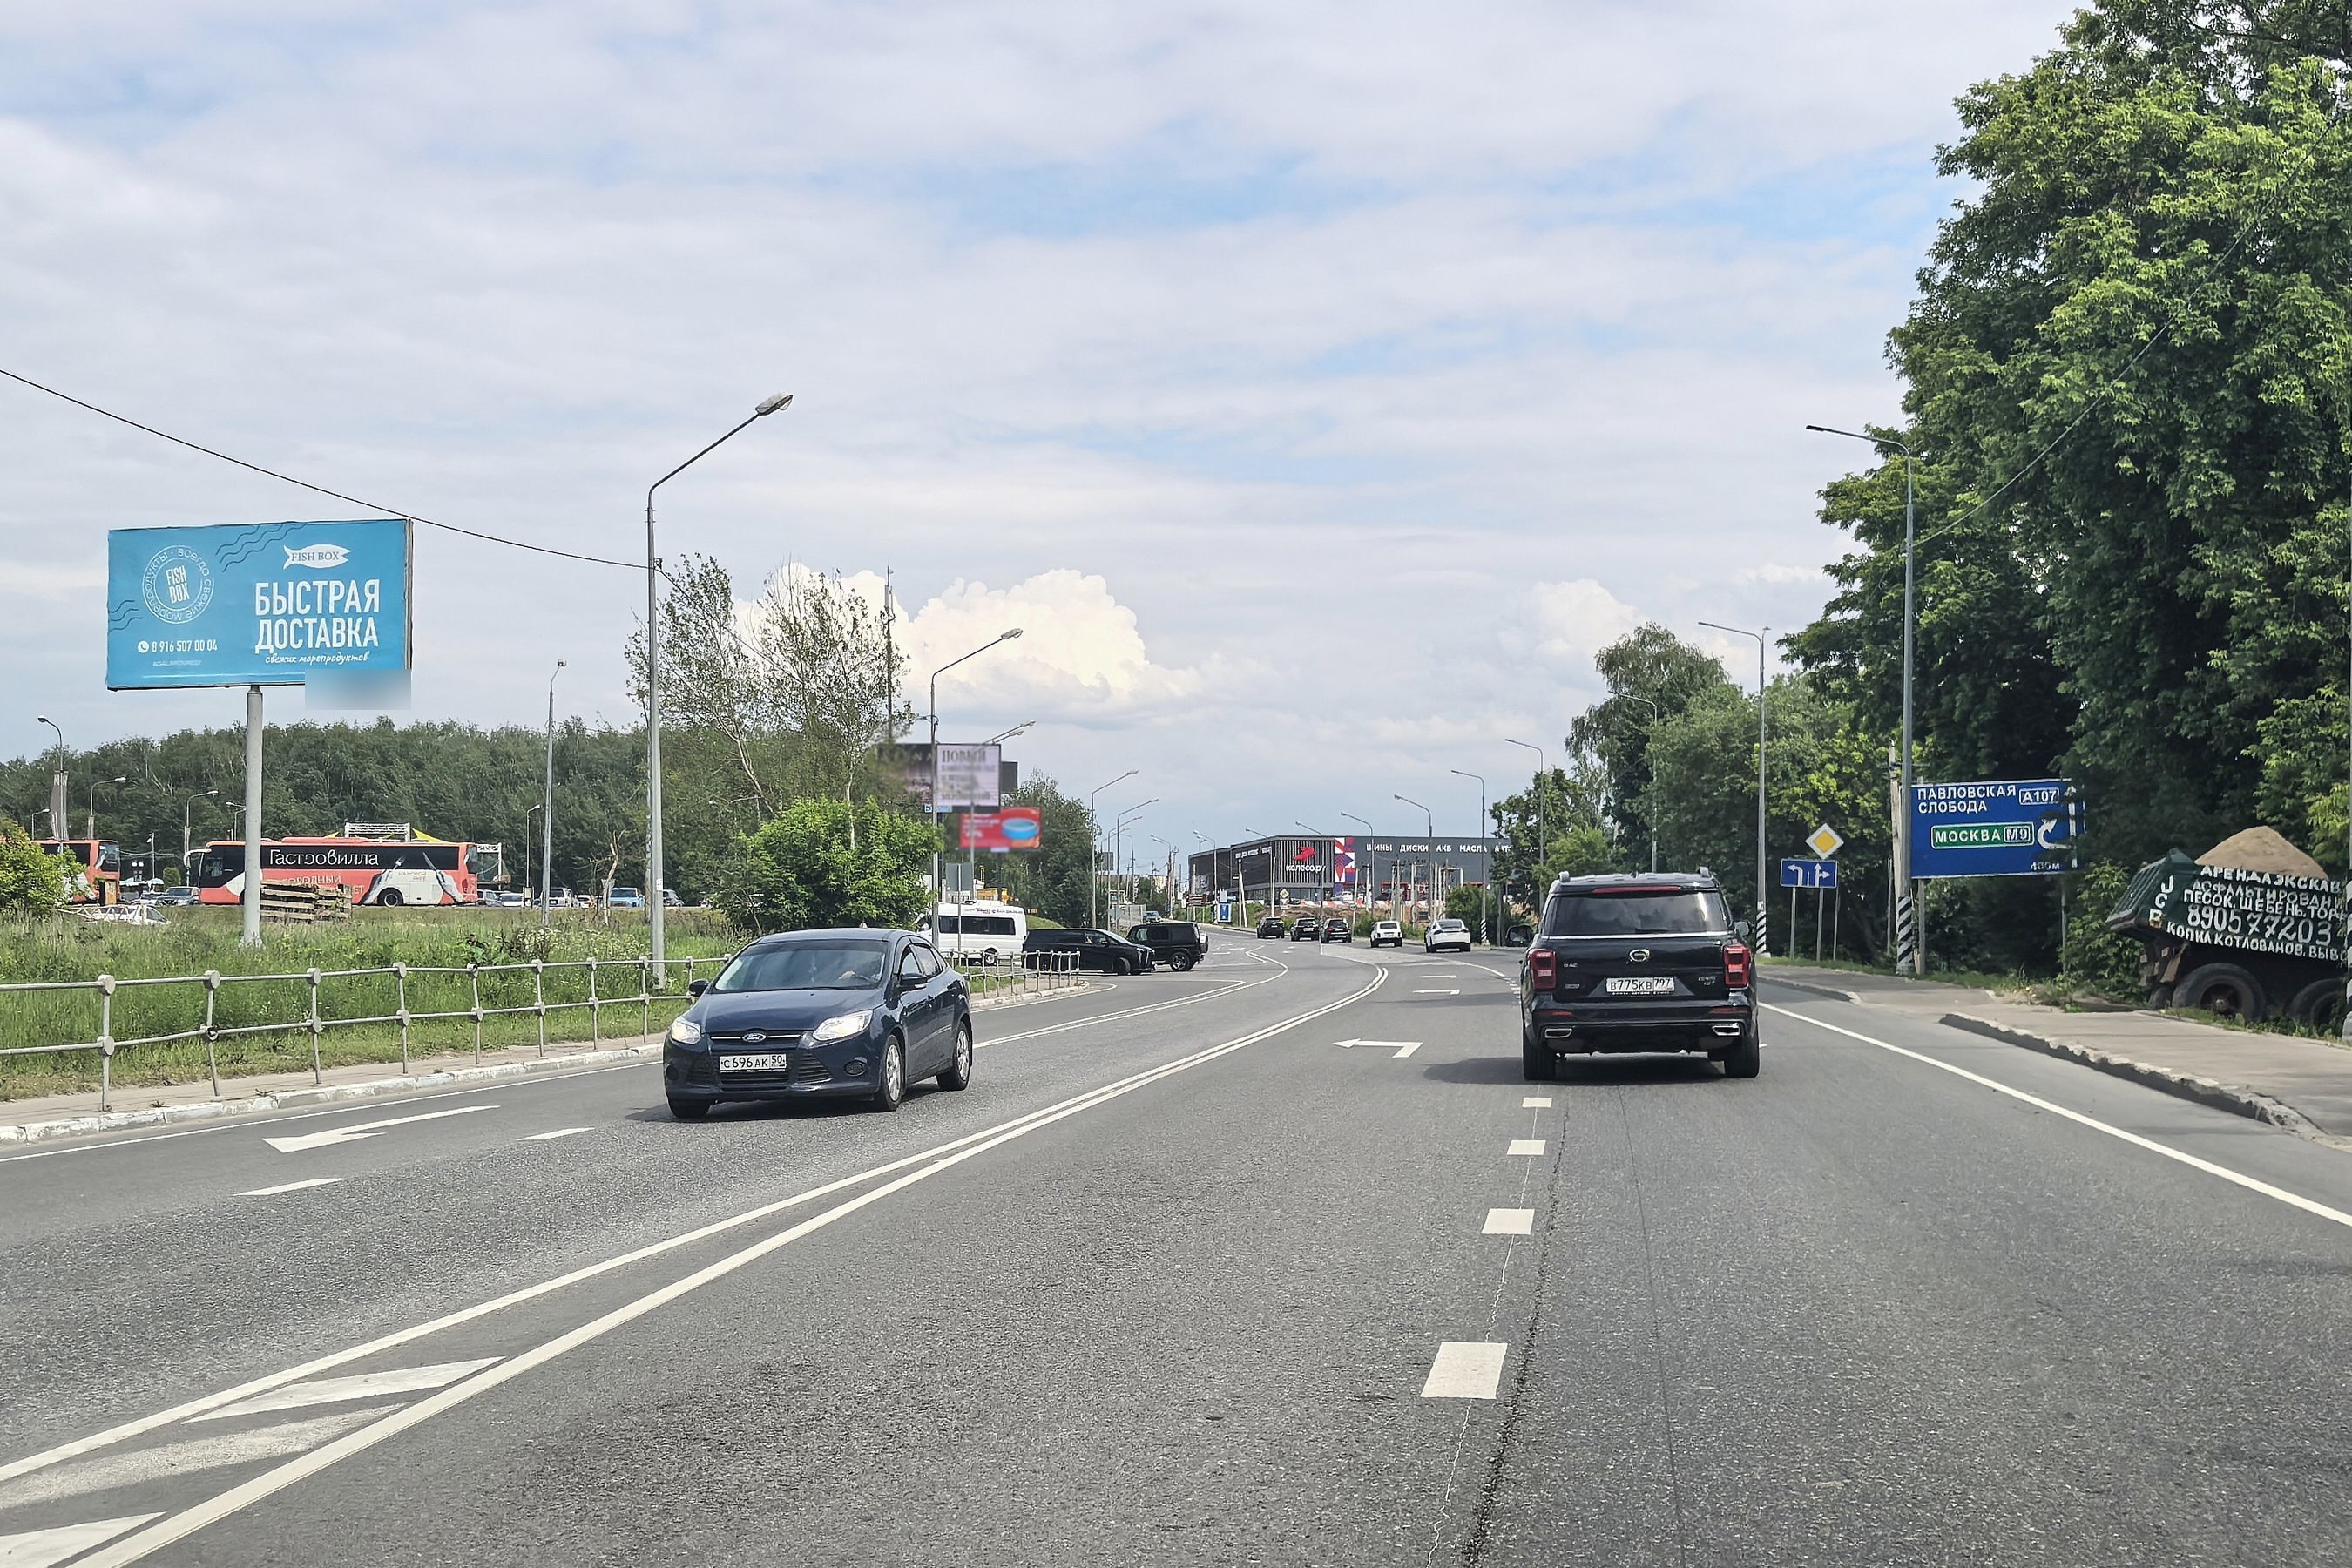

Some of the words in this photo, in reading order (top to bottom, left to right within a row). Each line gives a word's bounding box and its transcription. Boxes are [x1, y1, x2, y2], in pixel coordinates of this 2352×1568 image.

[292, 552, 314, 561] FISH
[318, 551, 340, 560] BOX
[166, 565, 187, 585] FISH
[169, 583, 190, 604] BOX
[255, 579, 380, 616] БЫСТРАЯ
[254, 617, 379, 654] ДОСТАВКА
[159, 641, 174, 652] 916
[177, 640, 192, 652] 507
[194, 639, 205, 651] 00
[207, 639, 218, 651] 04
[265, 653, 297, 664] свежих
[299, 651, 370, 666] морепродуктов
[1917, 784, 2017, 801] ПАВЛОВСКАЯ
[2023, 790, 2057, 803] А107
[1918, 800, 1987, 814] СЛОБОДА
[1935, 829, 2001, 843] МОСКВА
[2006, 828, 2029, 841] М9
[1366, 843, 1393, 852] ШИНЫ
[1399, 843, 1429, 853] ДИСКИ
[270, 848, 379, 865] Гастровилла
[2200, 865, 2272, 885] АРЕНДА
